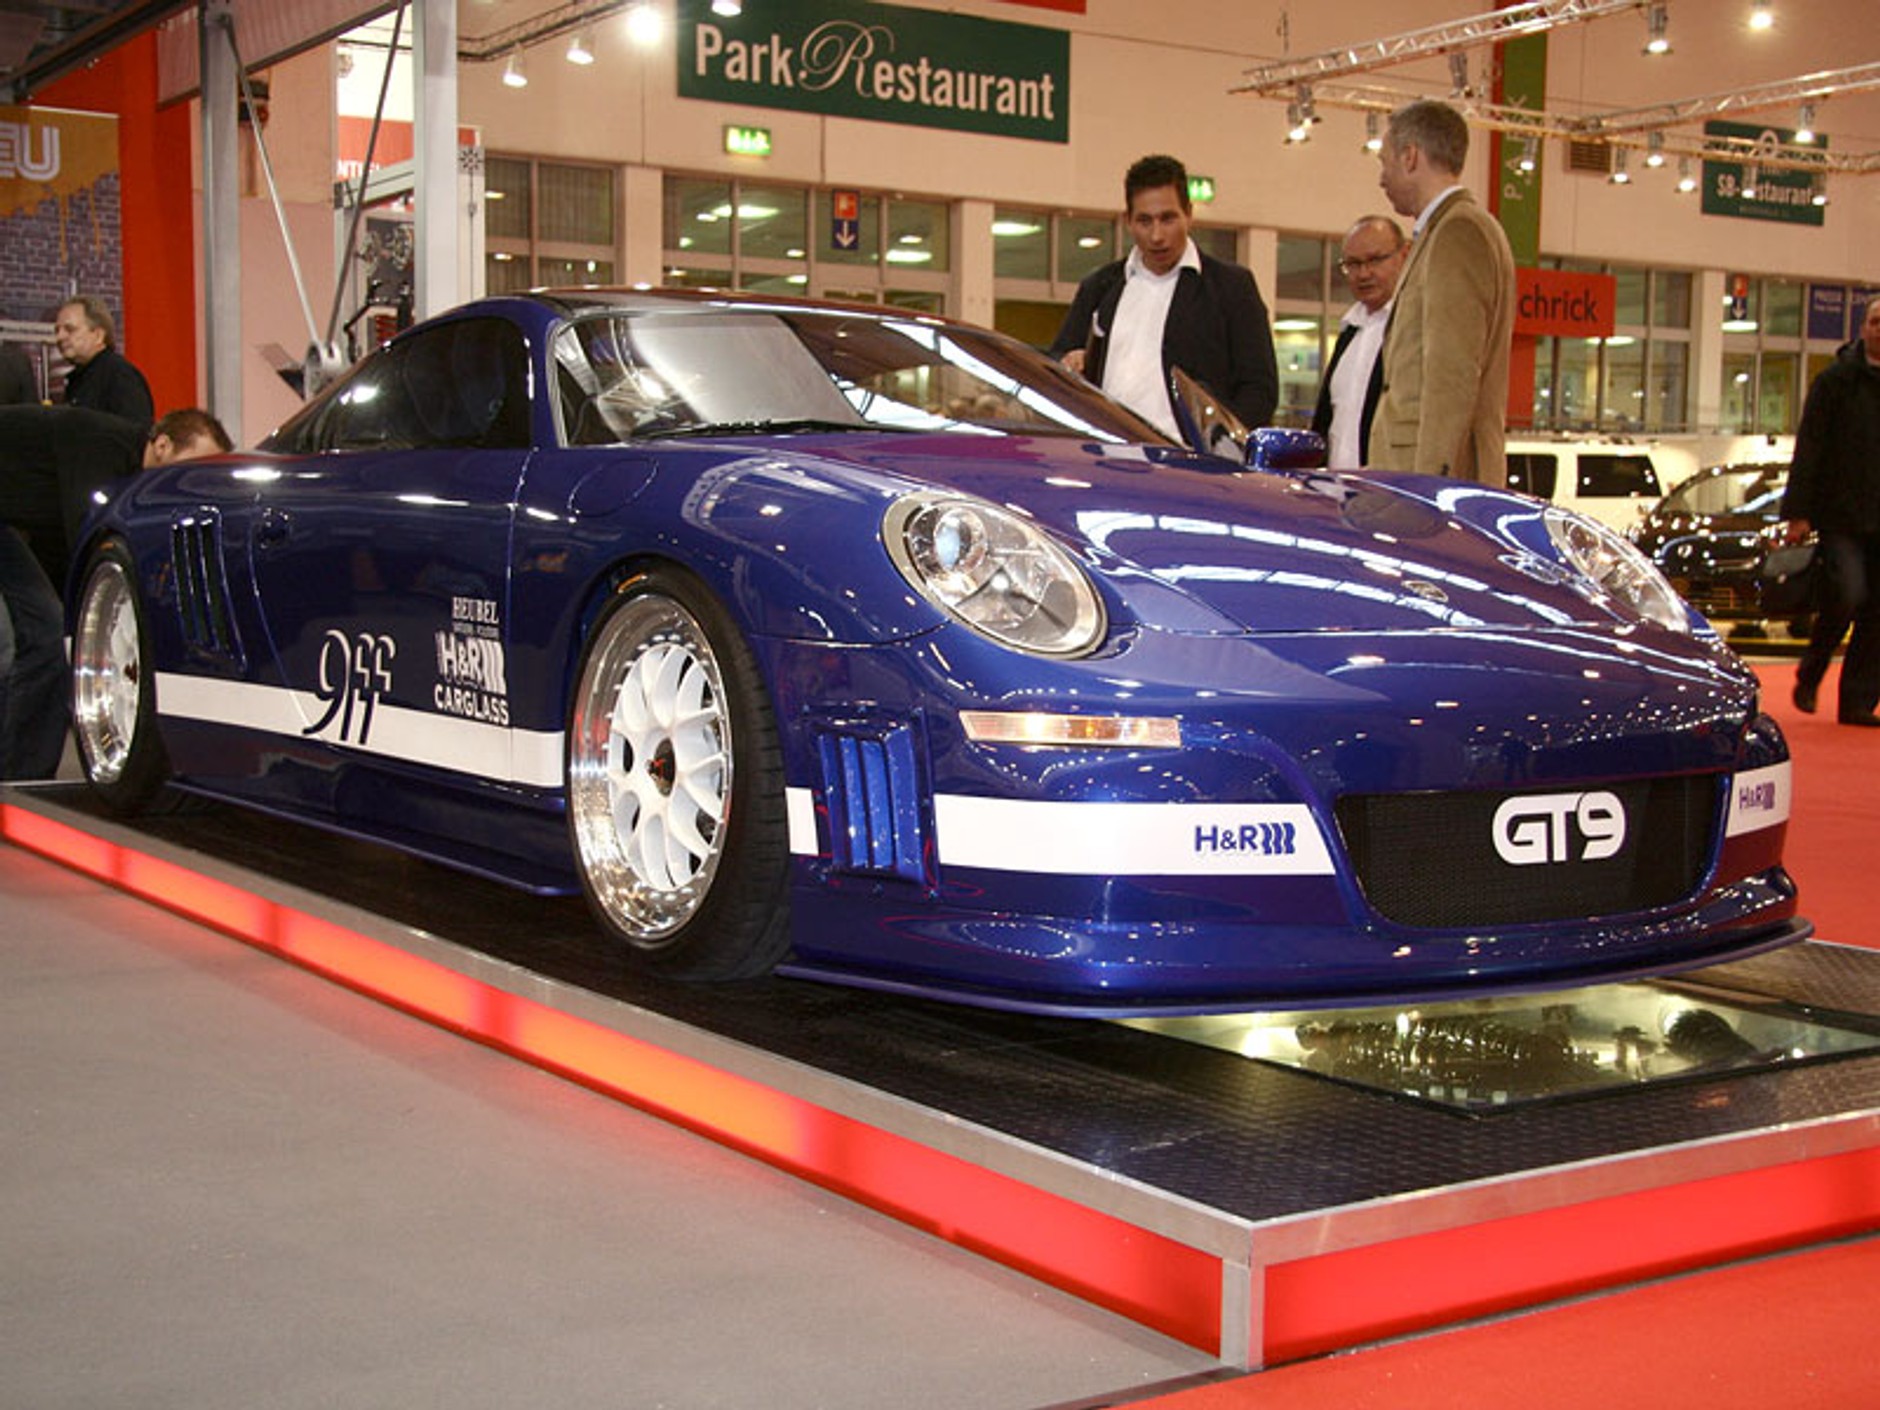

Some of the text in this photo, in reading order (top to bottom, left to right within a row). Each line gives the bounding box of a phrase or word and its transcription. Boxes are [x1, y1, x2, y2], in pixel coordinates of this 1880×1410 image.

[695, 19, 1055, 120] Park Restaurant
[1716, 171, 1816, 206] SB-staurant
[1518, 283, 1599, 323] chrick
[434, 683, 510, 726] CARGLASS
[1492, 791, 1627, 864] GT9
